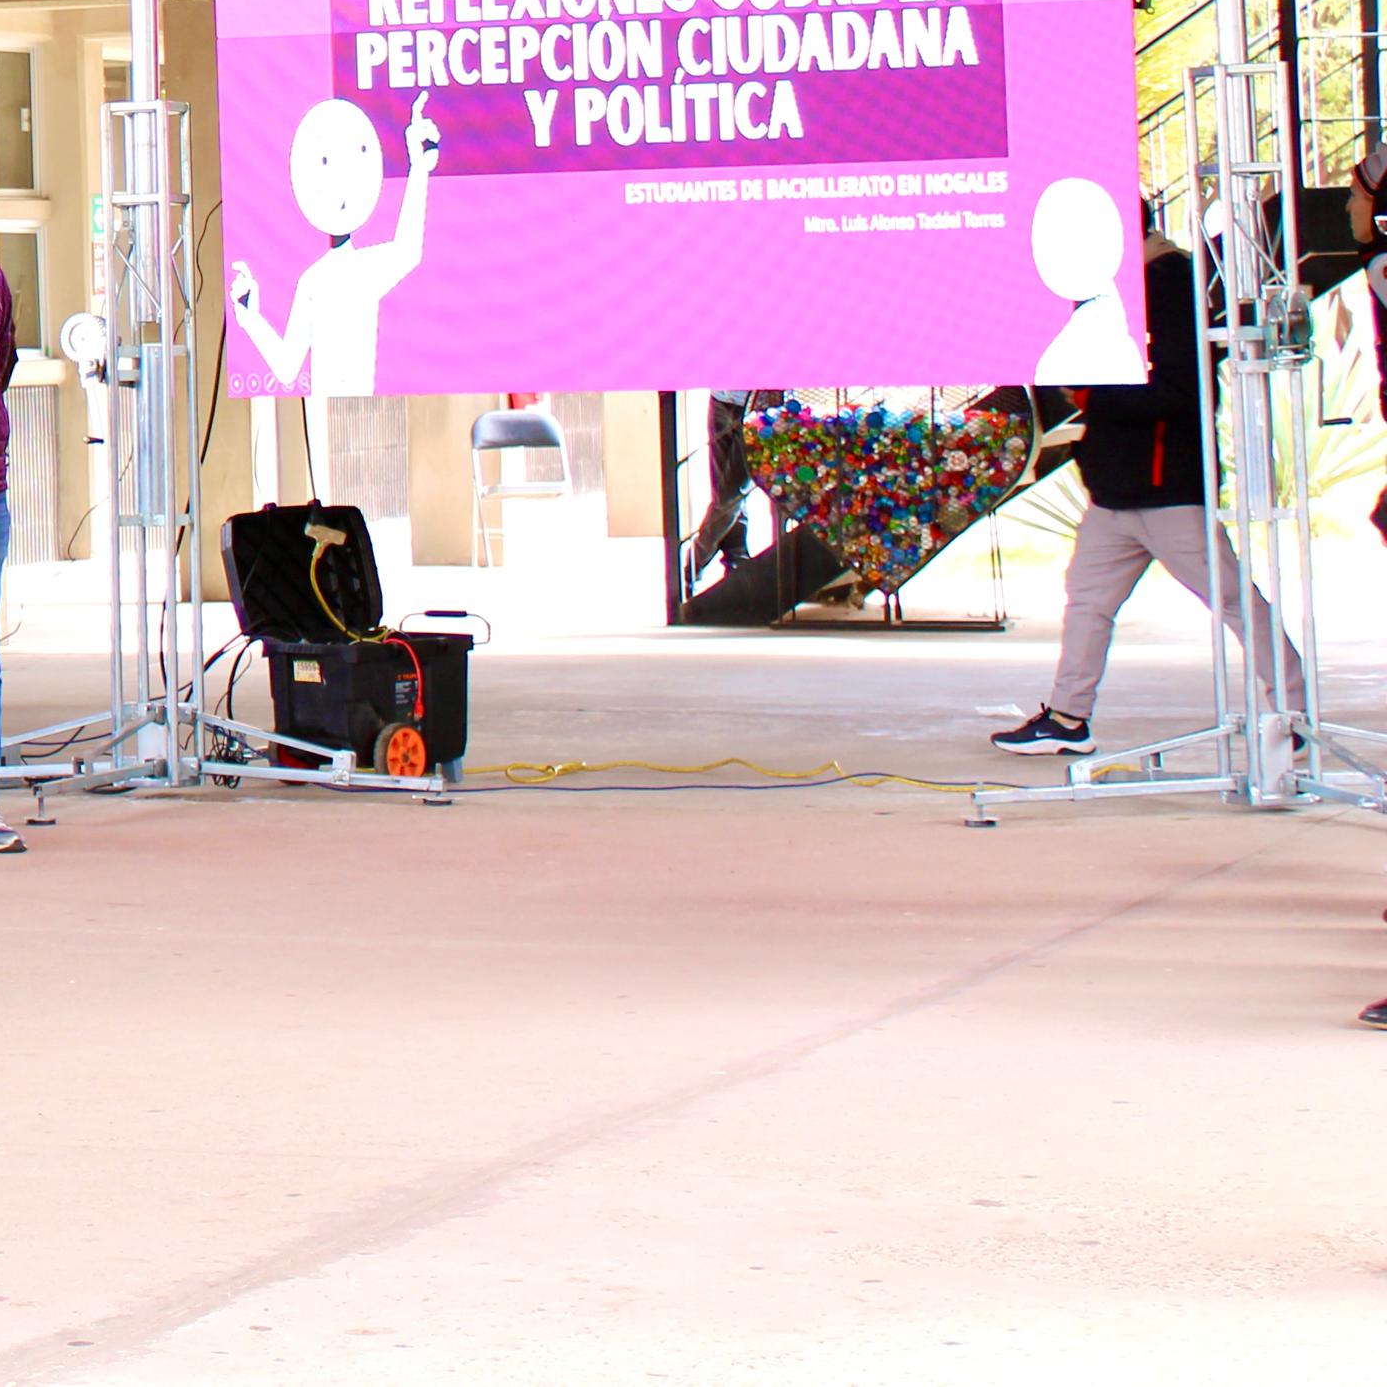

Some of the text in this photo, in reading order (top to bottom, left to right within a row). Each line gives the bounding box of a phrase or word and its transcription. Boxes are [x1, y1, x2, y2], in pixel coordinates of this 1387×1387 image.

[355, 5, 980, 90] PERCEPCIÓN CIUDADANA
[524, 67, 804, 148] Y POLÍTICA
[625, 171, 1009, 204] ESTUDIANTES DE BACHILLERATO EN NOGALES
[803, 216, 840, 233] Mtro.
[841, 214, 868, 232] Luis
[870, 213, 916, 232] Alonso
[962, 210, 1006, 229] Torres
